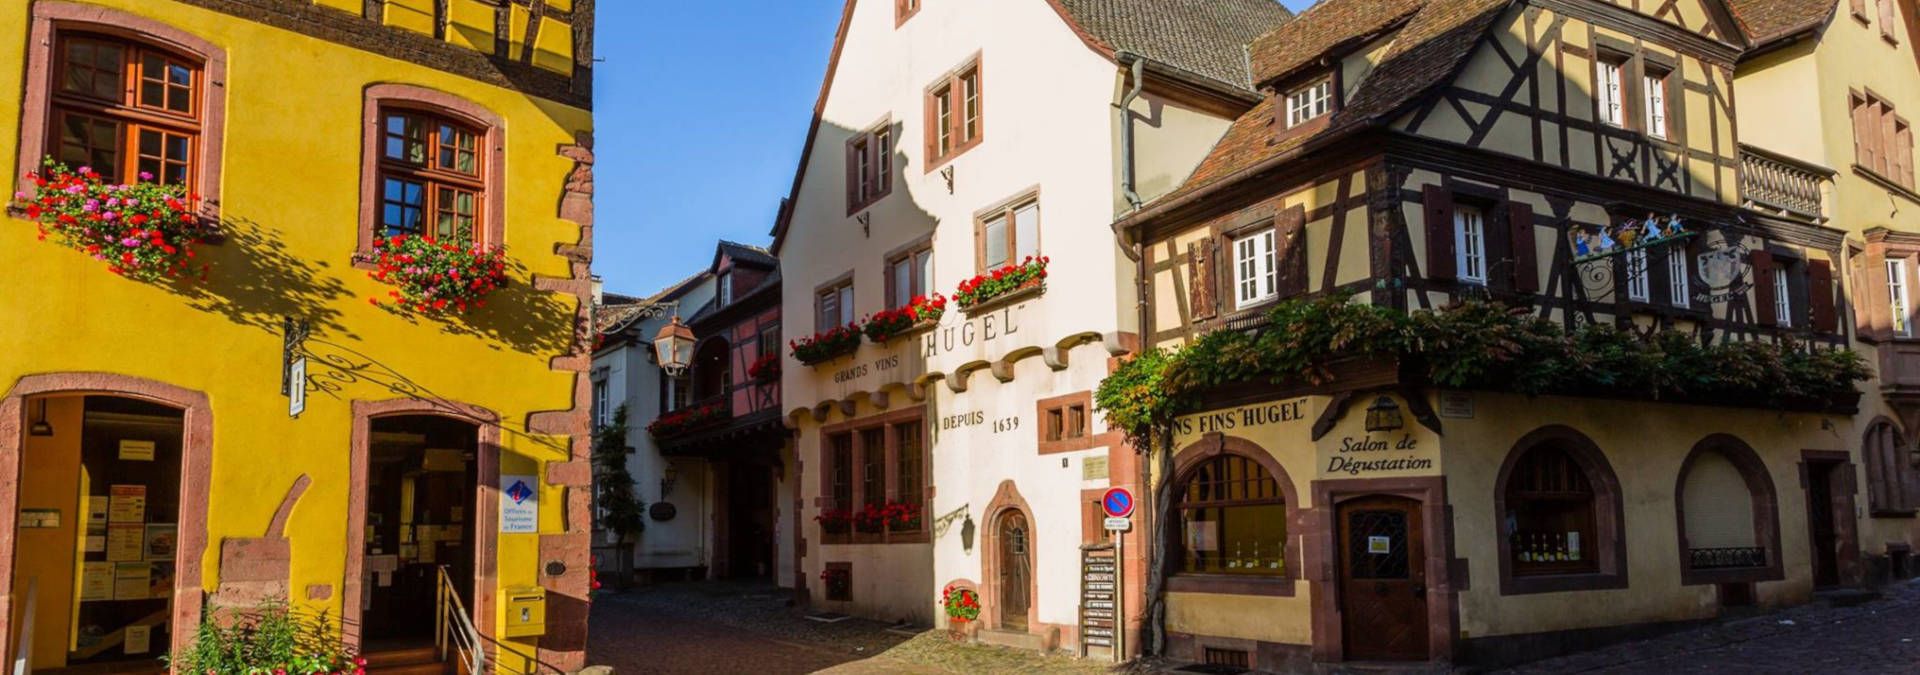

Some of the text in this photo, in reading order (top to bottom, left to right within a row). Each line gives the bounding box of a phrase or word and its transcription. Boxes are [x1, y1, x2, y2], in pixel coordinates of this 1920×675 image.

[833, 354, 899, 384] GRANDS VINS
[943, 410, 984, 431] DEPUIS
[993, 416, 1020, 434] 1639
[1199, 411, 1236, 433] FINS
[1339, 433, 1417, 453] Salon de
[1327, 455, 1432, 475] Dégustation
